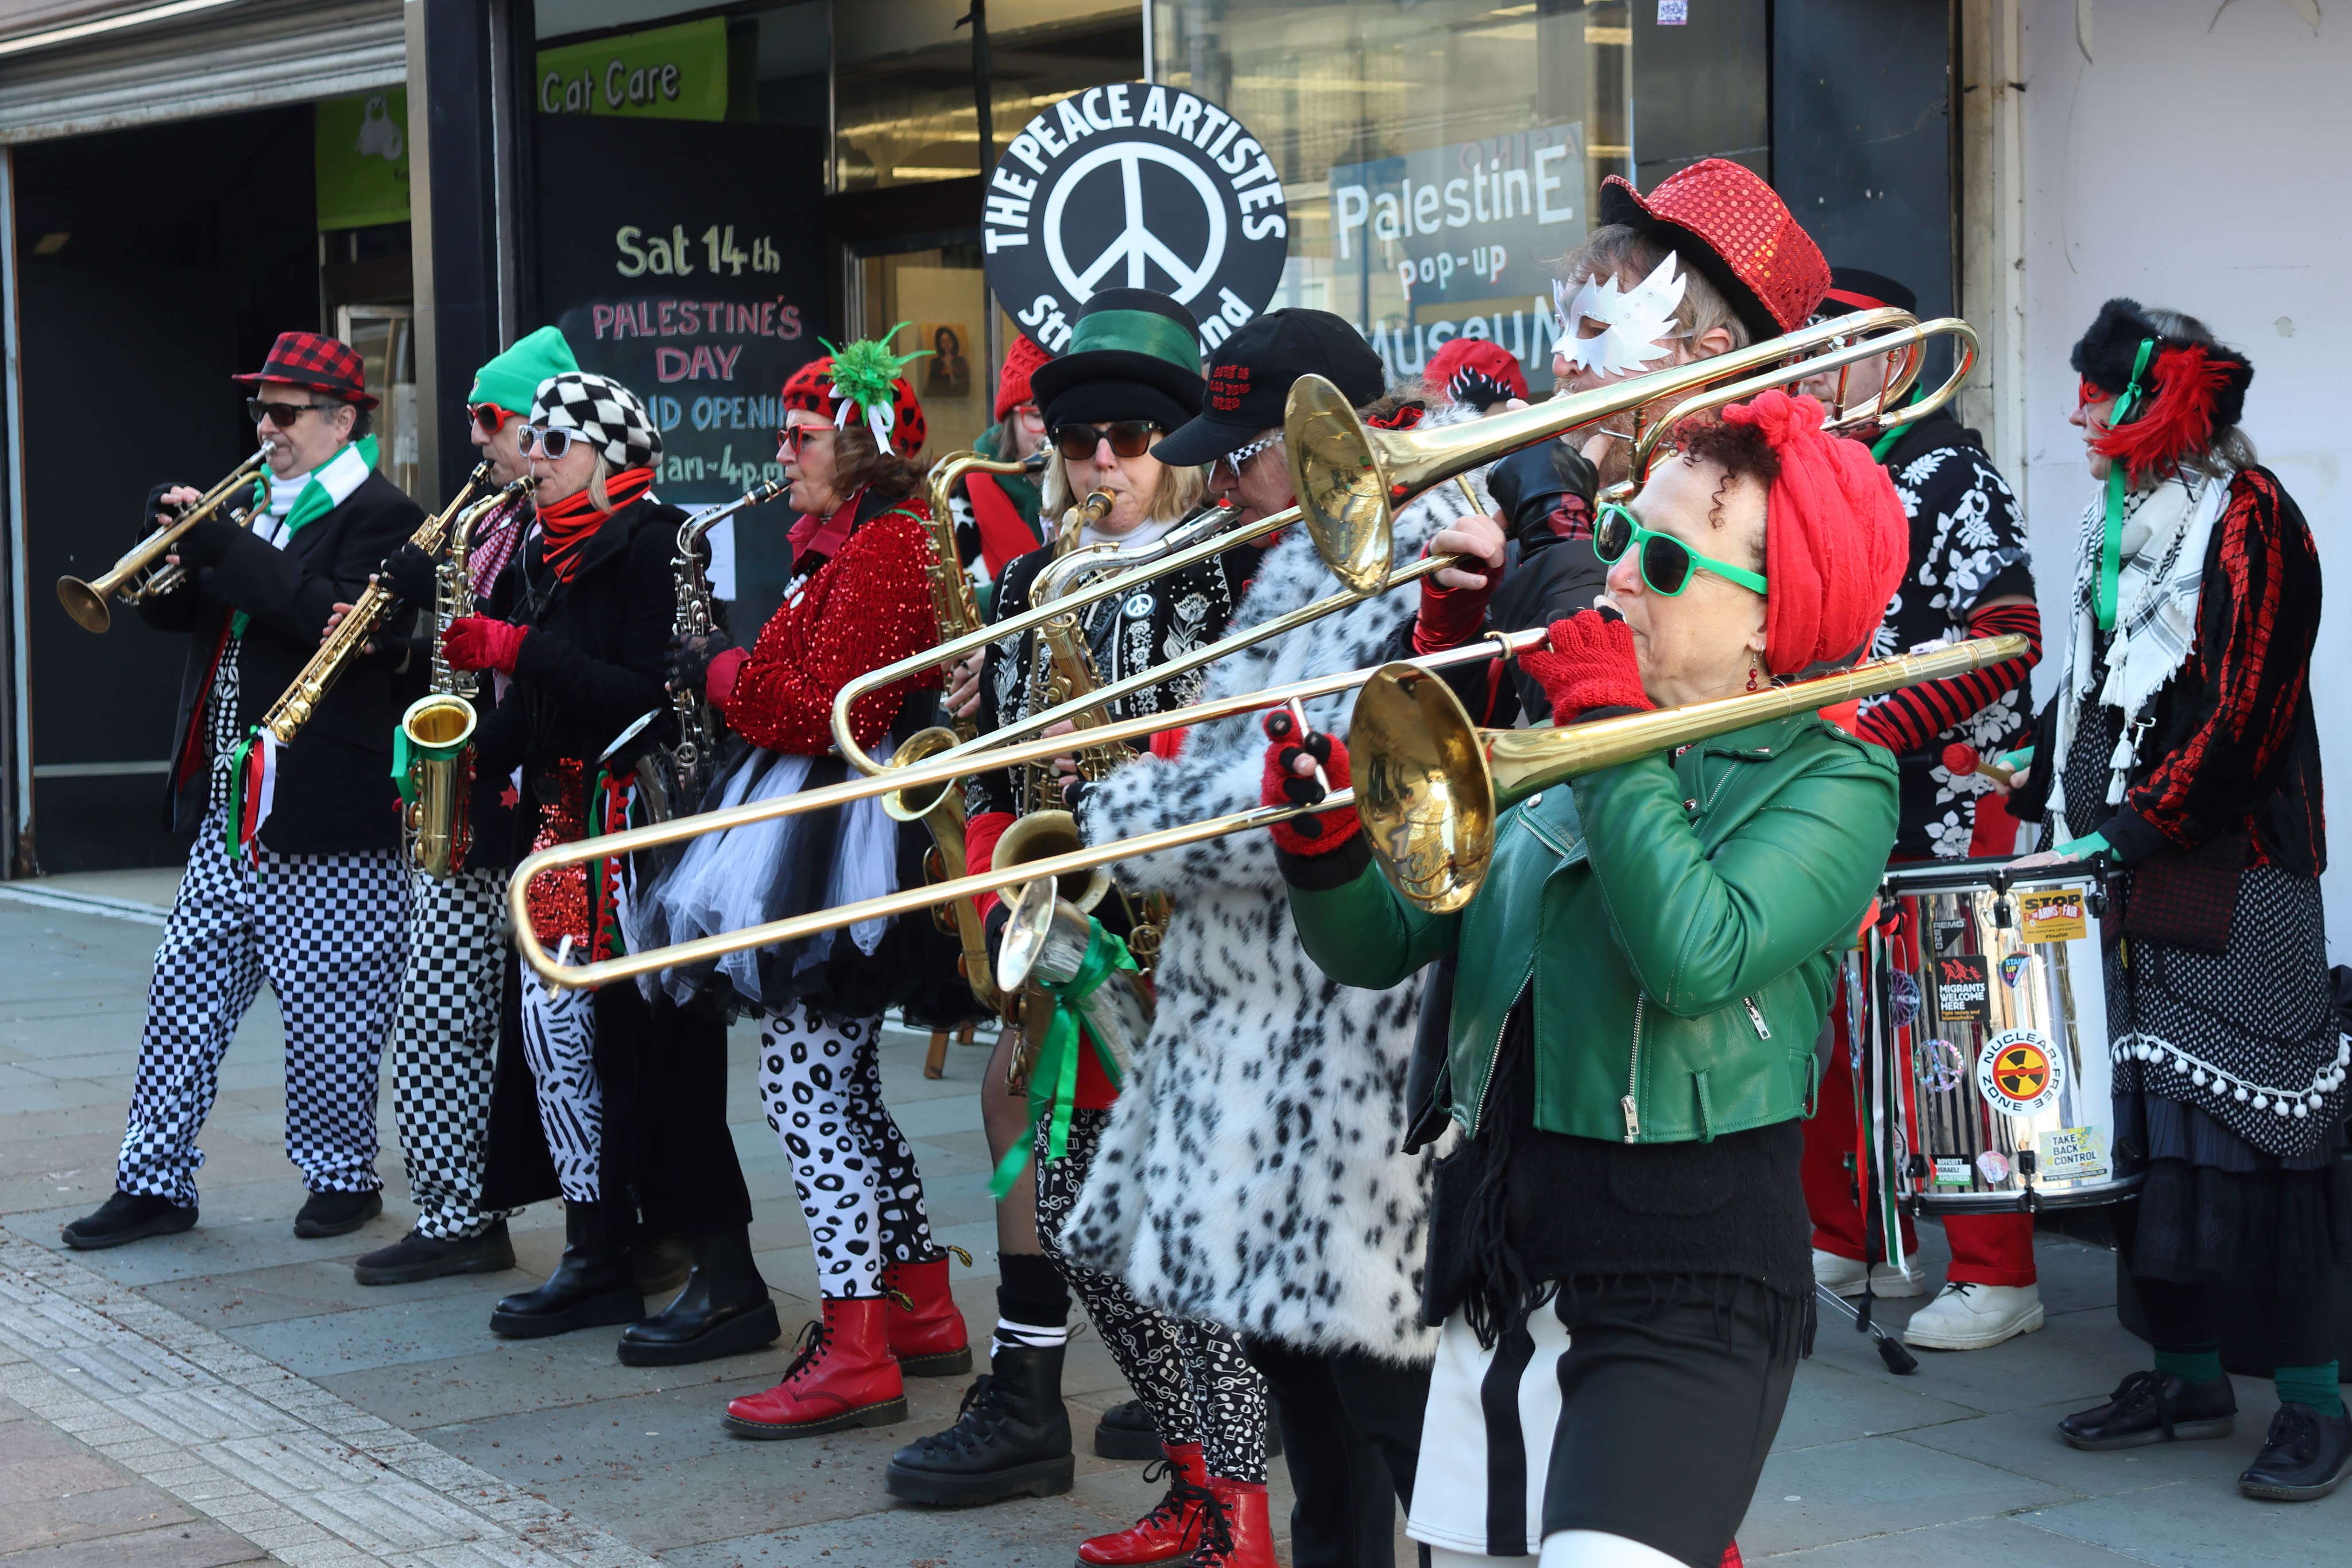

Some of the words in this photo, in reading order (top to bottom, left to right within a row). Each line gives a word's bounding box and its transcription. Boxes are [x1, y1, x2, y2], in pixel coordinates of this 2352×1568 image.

[542, 68, 594, 113] Cat
[605, 60, 678, 107] Care
[1008, 84, 1134, 175] PEACE
[1139, 86, 1286, 241] ARTISTES
[984, 167, 1038, 254] THE
[616, 224, 694, 277] Sat
[593, 295, 802, 340] PALESTINE'S
[1018, 294, 1073, 353] Str
[655, 344, 742, 382] DAY
[2025, 894, 2080, 910] STOP
[2038, 905, 2059, 920] ARMS
[2062, 904, 2078, 918] FAIR
[1933, 920, 1964, 929] REMO
[2005, 958, 2022, 966] STAN
[1939, 983, 1986, 993] MIGRANTS
[1939, 992, 1984, 1002] WELCOME
[1940, 1001, 1965, 1011] HERE
[1983, 1075, 2023, 1112] ZONE
[2052, 1133, 2076, 1145] TAKE
[2053, 1144, 2078, 1155] BACK
[2054, 1151, 2096, 1166] CONTROL
